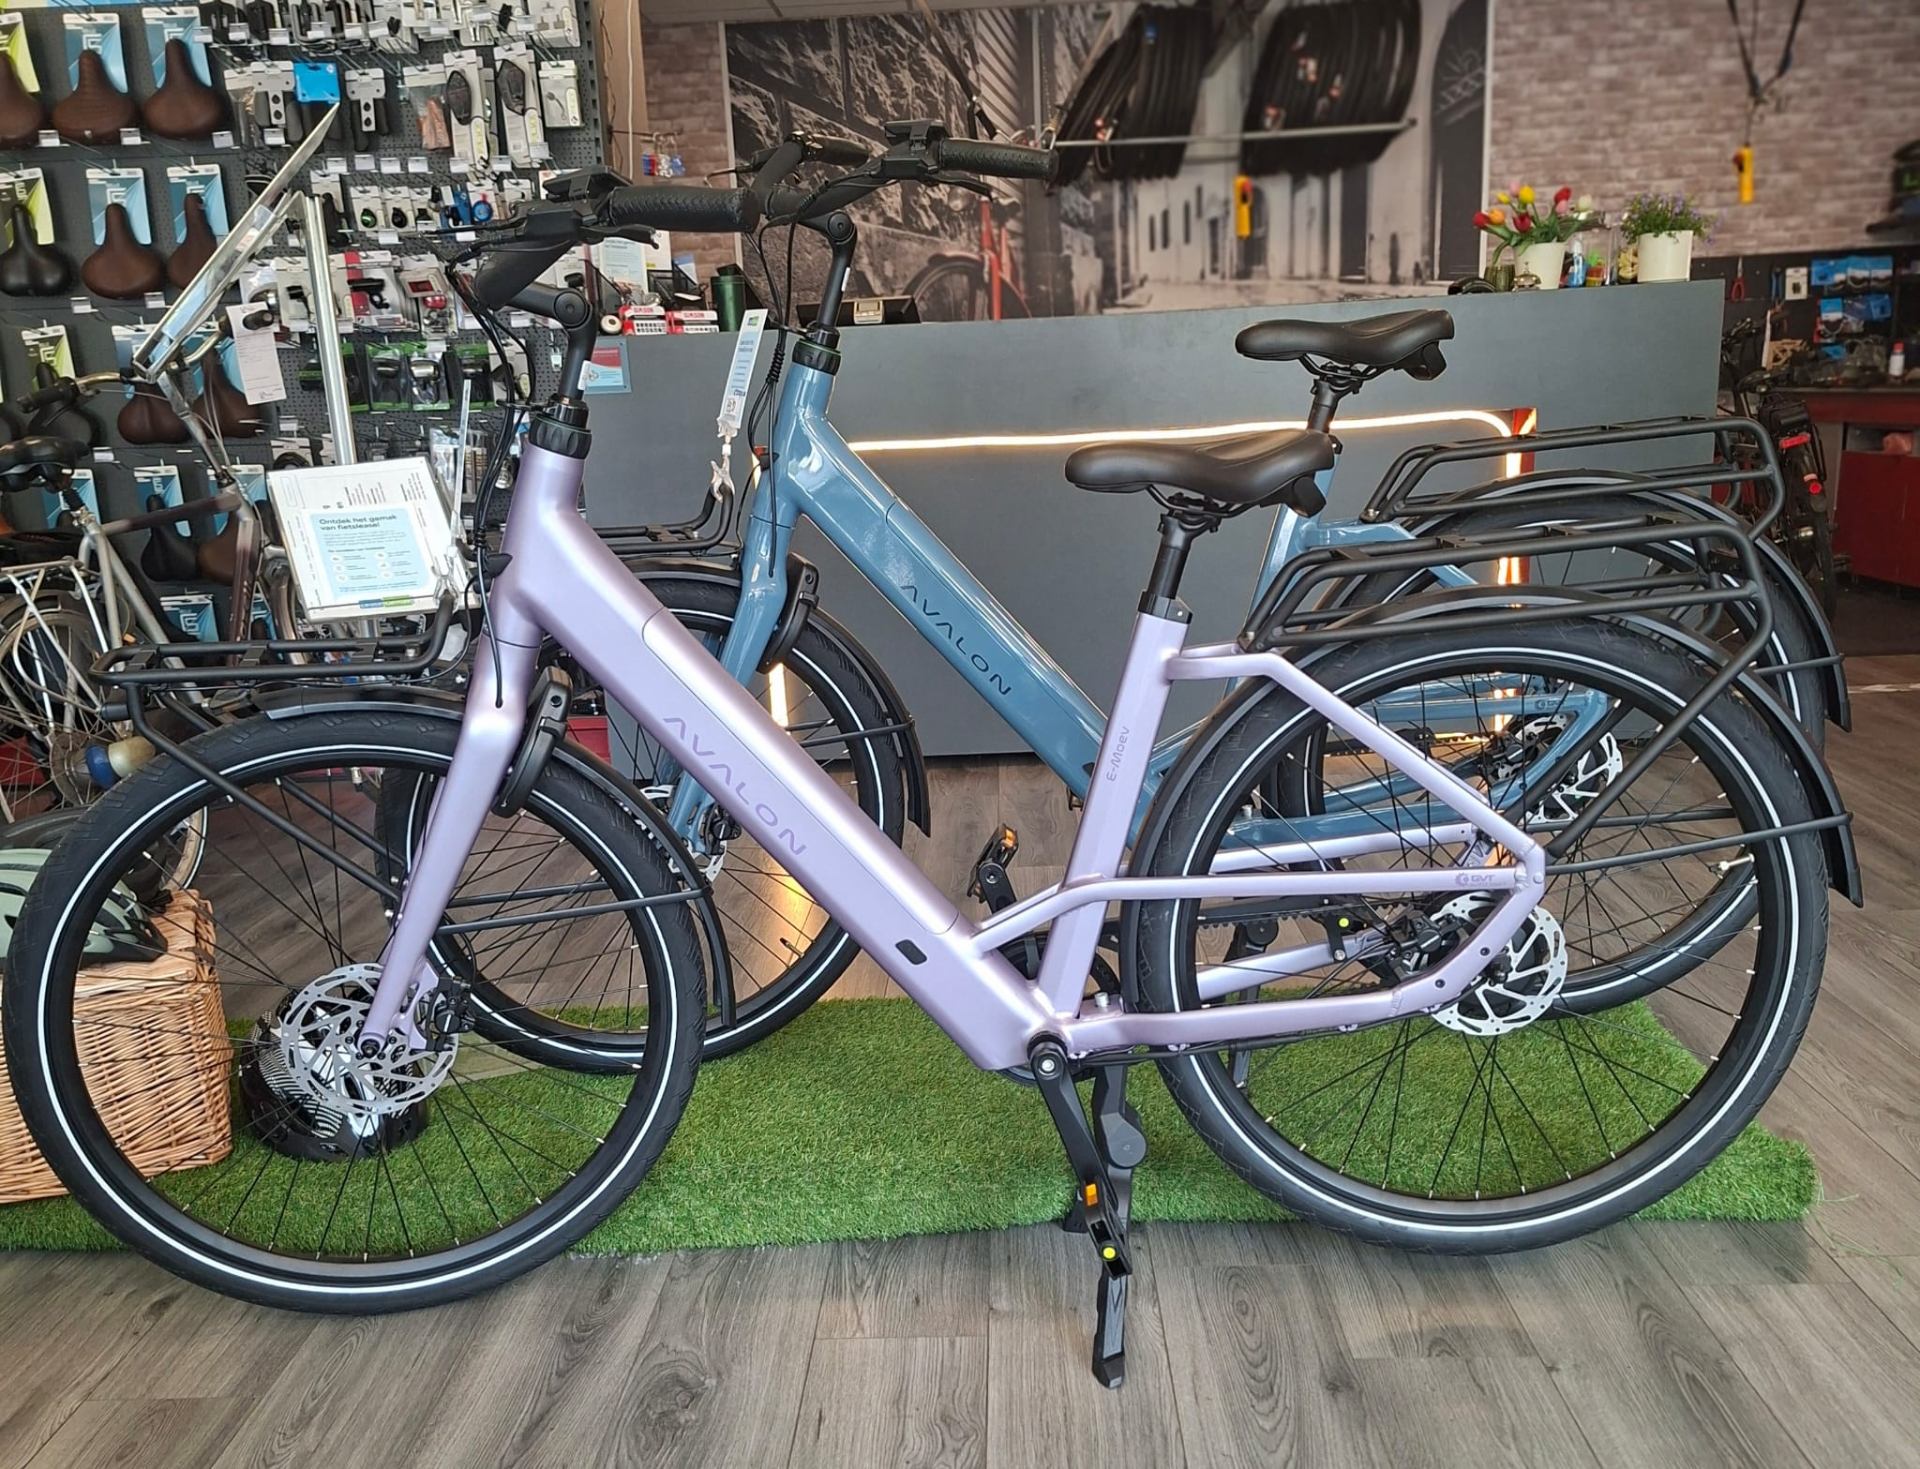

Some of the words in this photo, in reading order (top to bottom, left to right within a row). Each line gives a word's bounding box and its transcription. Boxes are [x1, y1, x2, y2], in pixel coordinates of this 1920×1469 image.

[900, 585, 1012, 695] AVALON
[663, 717, 808, 856] AVALON
[1106, 726, 1130, 782] E-Moev
